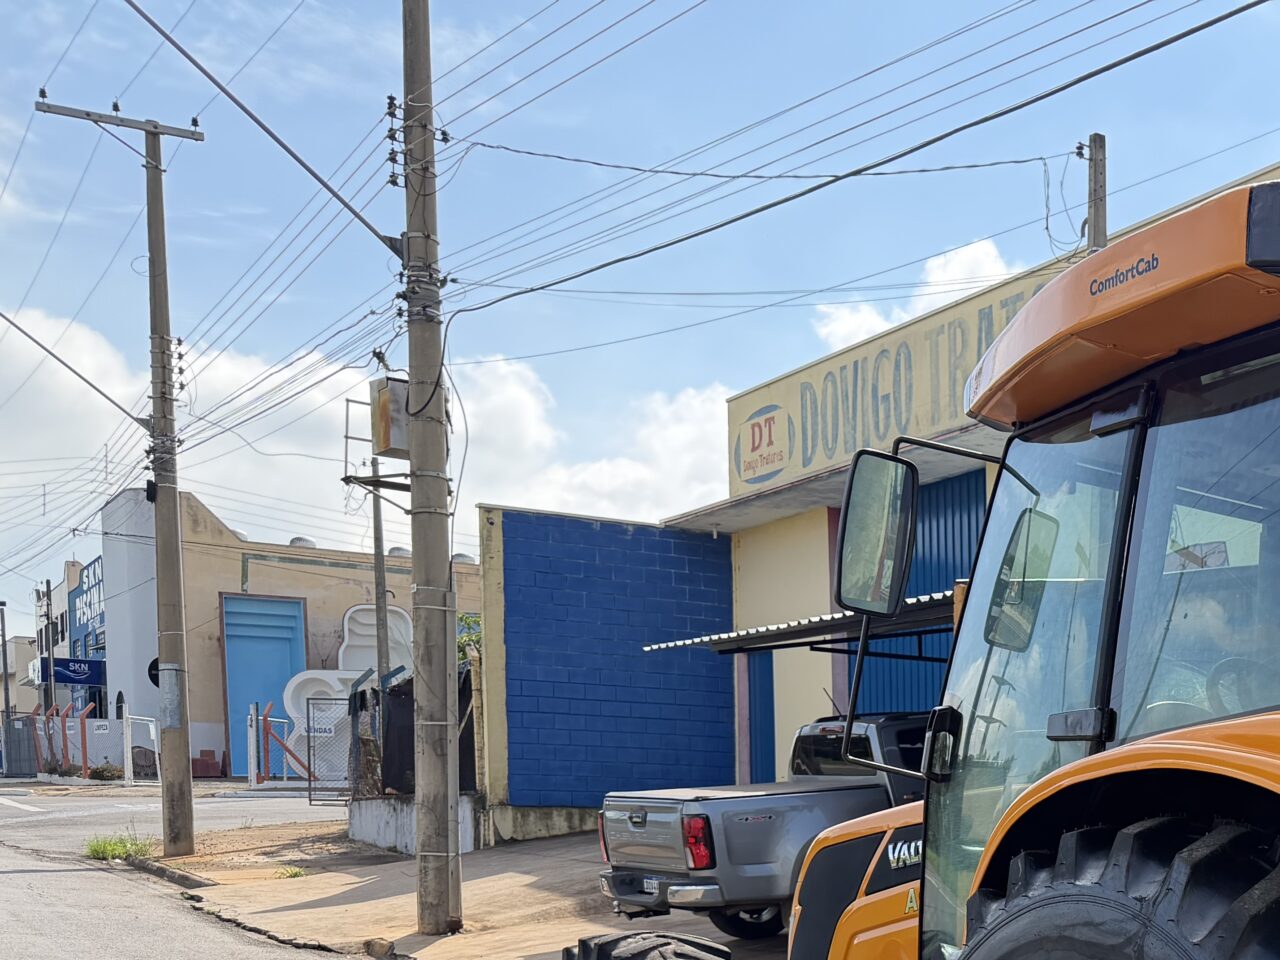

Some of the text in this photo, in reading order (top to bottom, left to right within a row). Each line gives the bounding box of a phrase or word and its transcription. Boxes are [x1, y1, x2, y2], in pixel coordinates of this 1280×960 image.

[1089, 253, 1159, 296] ComfortCab
[800, 281, 1046, 469] DOVIGO TRAT
[751, 416, 775, 453] DT
[82, 558, 103, 591] SKN
[69, 662, 89, 671] SKN
